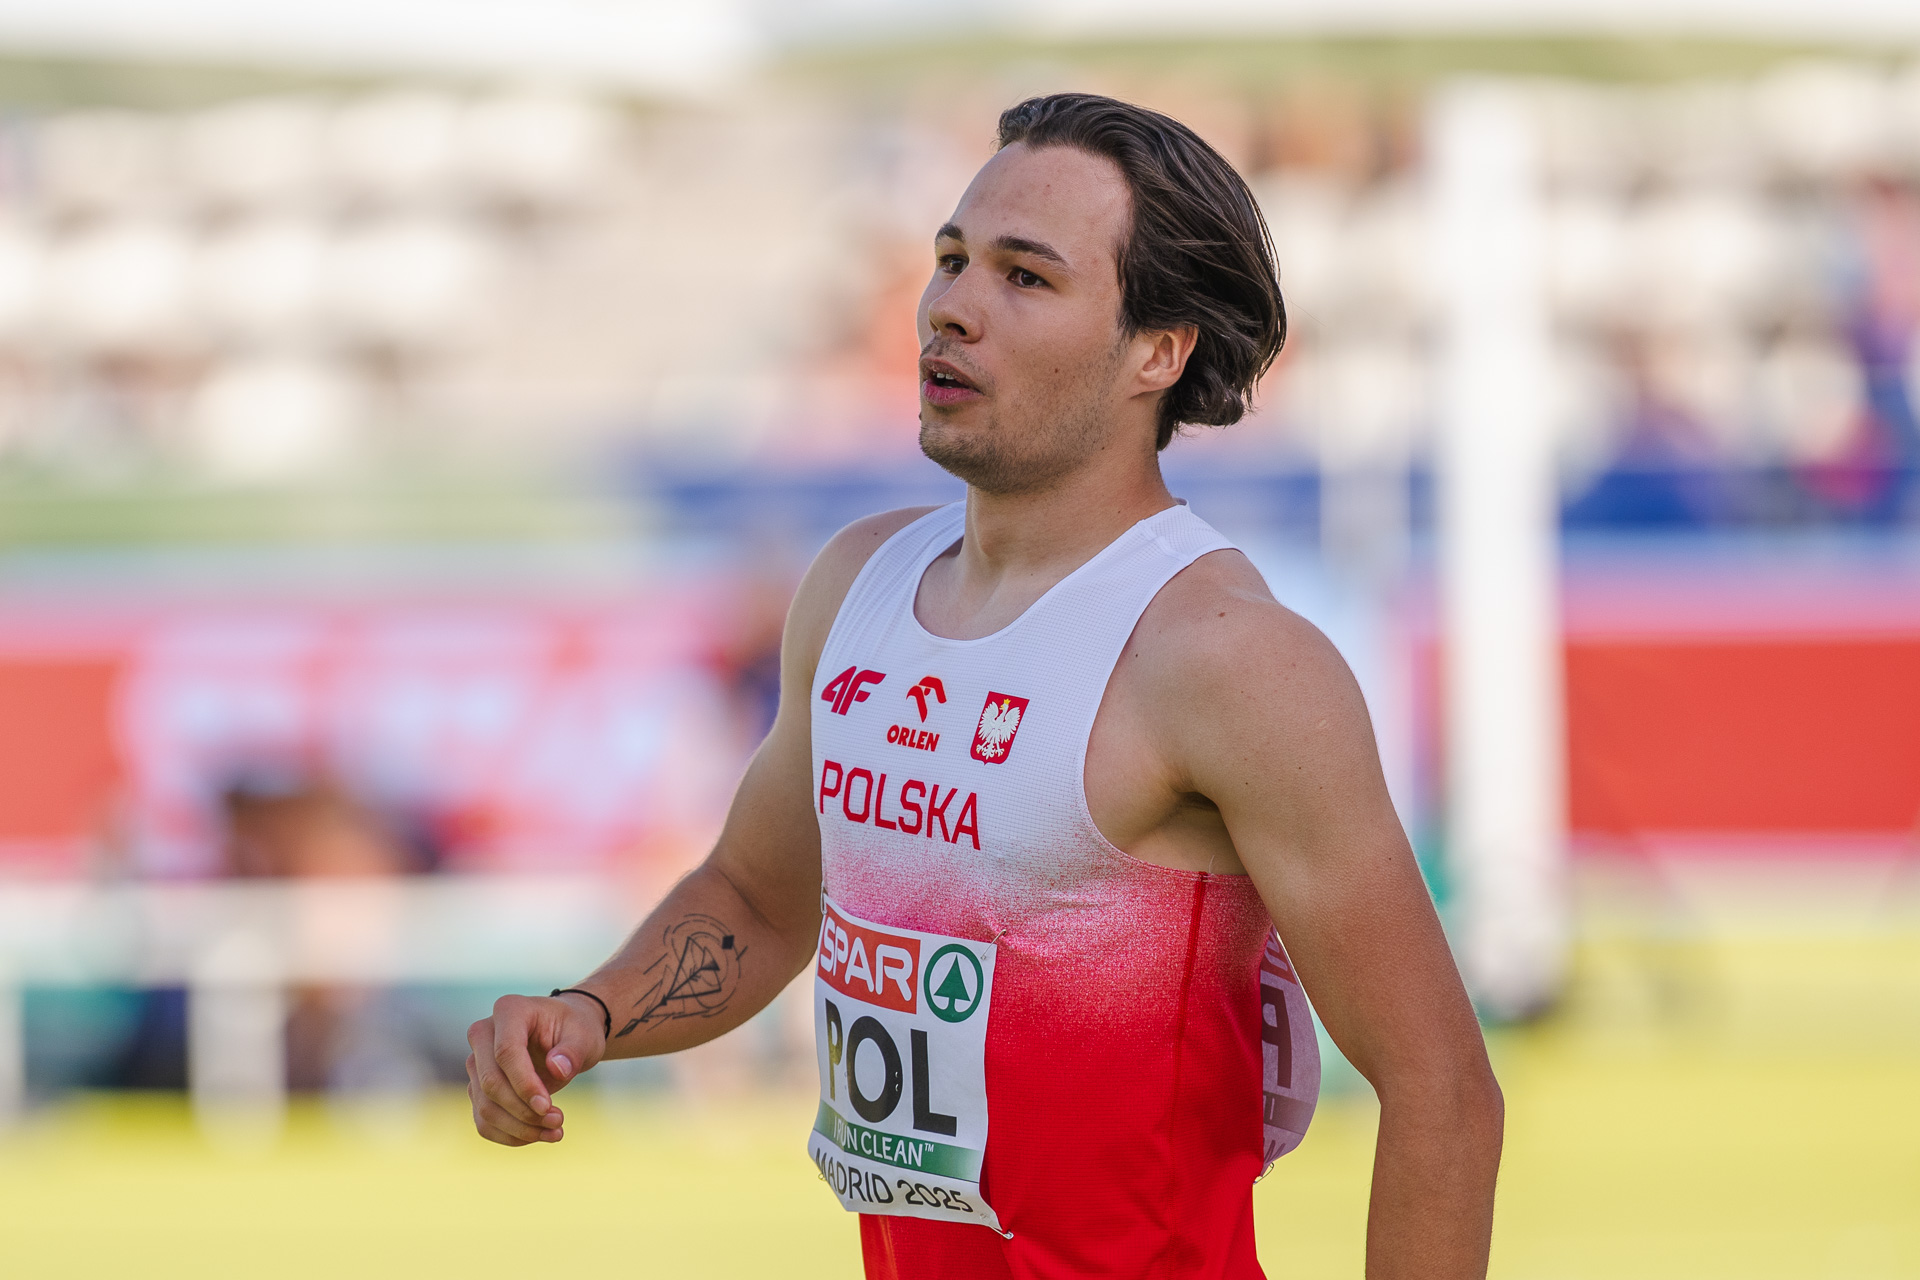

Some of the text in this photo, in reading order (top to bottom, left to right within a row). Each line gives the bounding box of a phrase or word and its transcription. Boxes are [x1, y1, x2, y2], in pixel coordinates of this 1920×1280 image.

[821, 665, 887, 716] 4F
[886, 725, 940, 752] ORLEN
[819, 759, 981, 851] POLSKA
[820, 918, 913, 1002] SPAR
[825, 997, 957, 1137] POL
[836, 1118, 858, 1151] RUN
[815, 1147, 974, 1213] MADRID 2025
